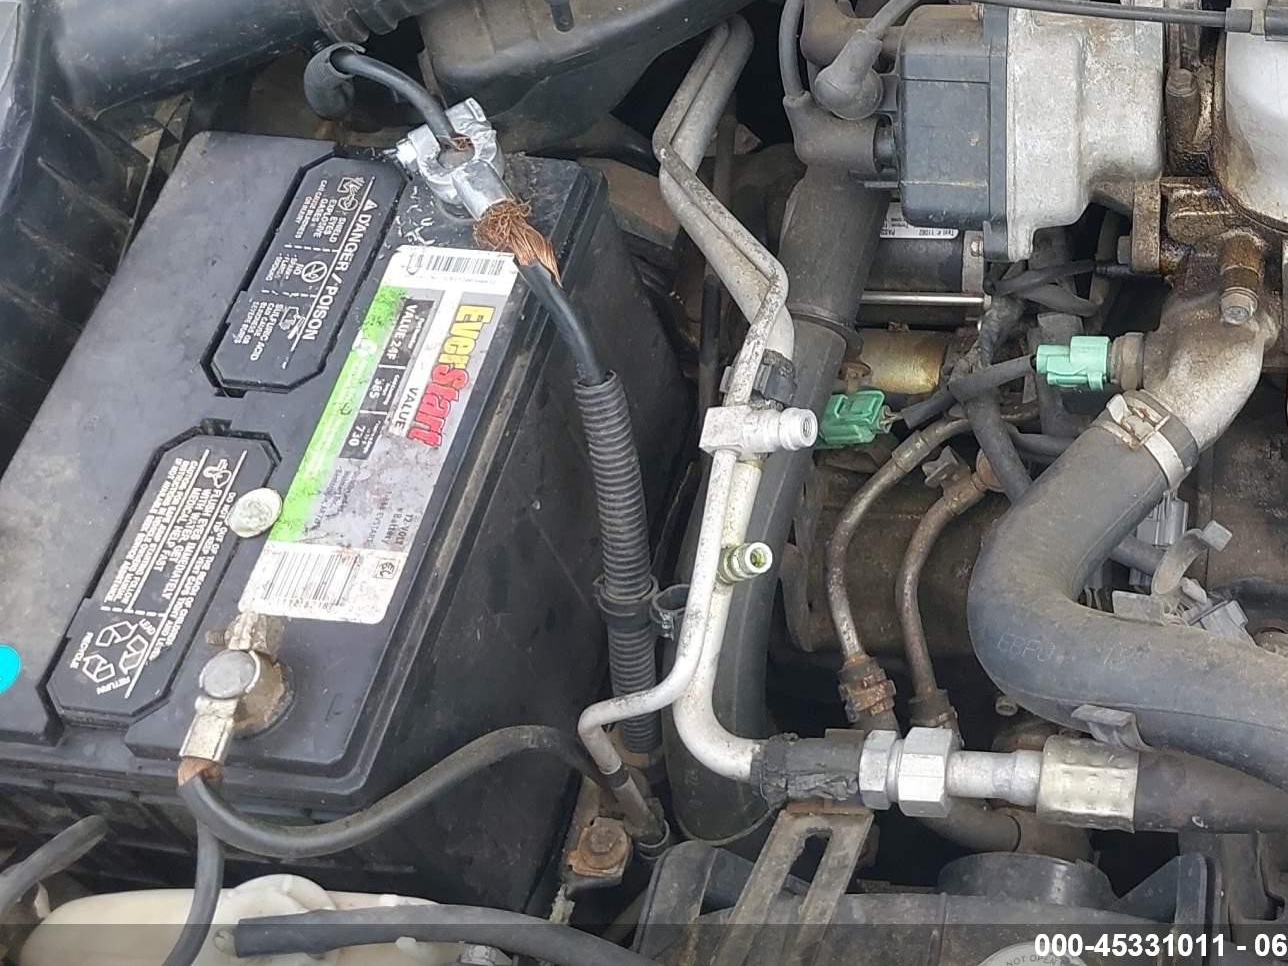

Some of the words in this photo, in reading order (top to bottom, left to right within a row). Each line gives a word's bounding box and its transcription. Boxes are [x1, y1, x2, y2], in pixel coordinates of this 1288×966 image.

[311, 198, 328, 222] GASES
[313, 199, 337, 237] EXPLOSIVE
[323, 216, 338, 235] EYES
[329, 217, 346, 243] SHIELD
[335, 214, 371, 271] DANGER
[293, 263, 304, 275] NO
[259, 304, 283, 341] SULFURIC
[303, 286, 338, 339] POISON
[394, 305, 417, 339] VALUE
[253, 316, 268, 337] CAUSE
[250, 341, 265, 361] ACID
[386, 340, 402, 360] 24F
[406, 304, 496, 447] EverStart
[395, 387, 420, 432] VALUE
[348, 425, 366, 446] 730
[167, 465, 178, 479] NOT
[162, 460, 189, 506] INSTRUCTIONS
[149, 480, 171, 513] AVAILABLE
[169, 491, 183, 505] FOR
[176, 487, 201, 523] MEDICAL
[195, 488, 211, 510] WITH
[202, 489, 222, 517] FLUSH
[226, 492, 236, 502] DO
[157, 507, 167, 515] IN
[162, 505, 176, 523] SAFE
[218, 504, 230, 519] NOT
[140, 515, 154, 531] SEEK
[143, 516, 162, 542] VEHICLE
[153, 523, 166, 542] JUMP
[190, 518, 208, 540] EYES
[383, 511, 402, 544] Battery
[166, 525, 183, 548] HELP
[215, 526, 228, 542] OUT
[126, 532, 145, 559] SERVICE
[169, 545, 184, 562] GET
[202, 536, 215, 555] KEEP
[210, 543, 220, 554] OF
[135, 543, 157, 575] STARTING
[153, 549, 171, 571] FAST
[192, 556, 206, 574] VENT
[201, 556, 215, 570] THE
[162, 542, 196, 599] IMMEDIATELY
[121, 576, 140, 604] FOLLOW
[180, 575, 196, 595] CAPS
[188, 571, 206, 596] REACH
[170, 597, 186, 618] TIGHT
[181, 596, 194, 608] OF
[161, 620, 173, 636] AND
[69, 631, 95, 670] RECYCLE
[95, 675, 131, 696] RETURN
